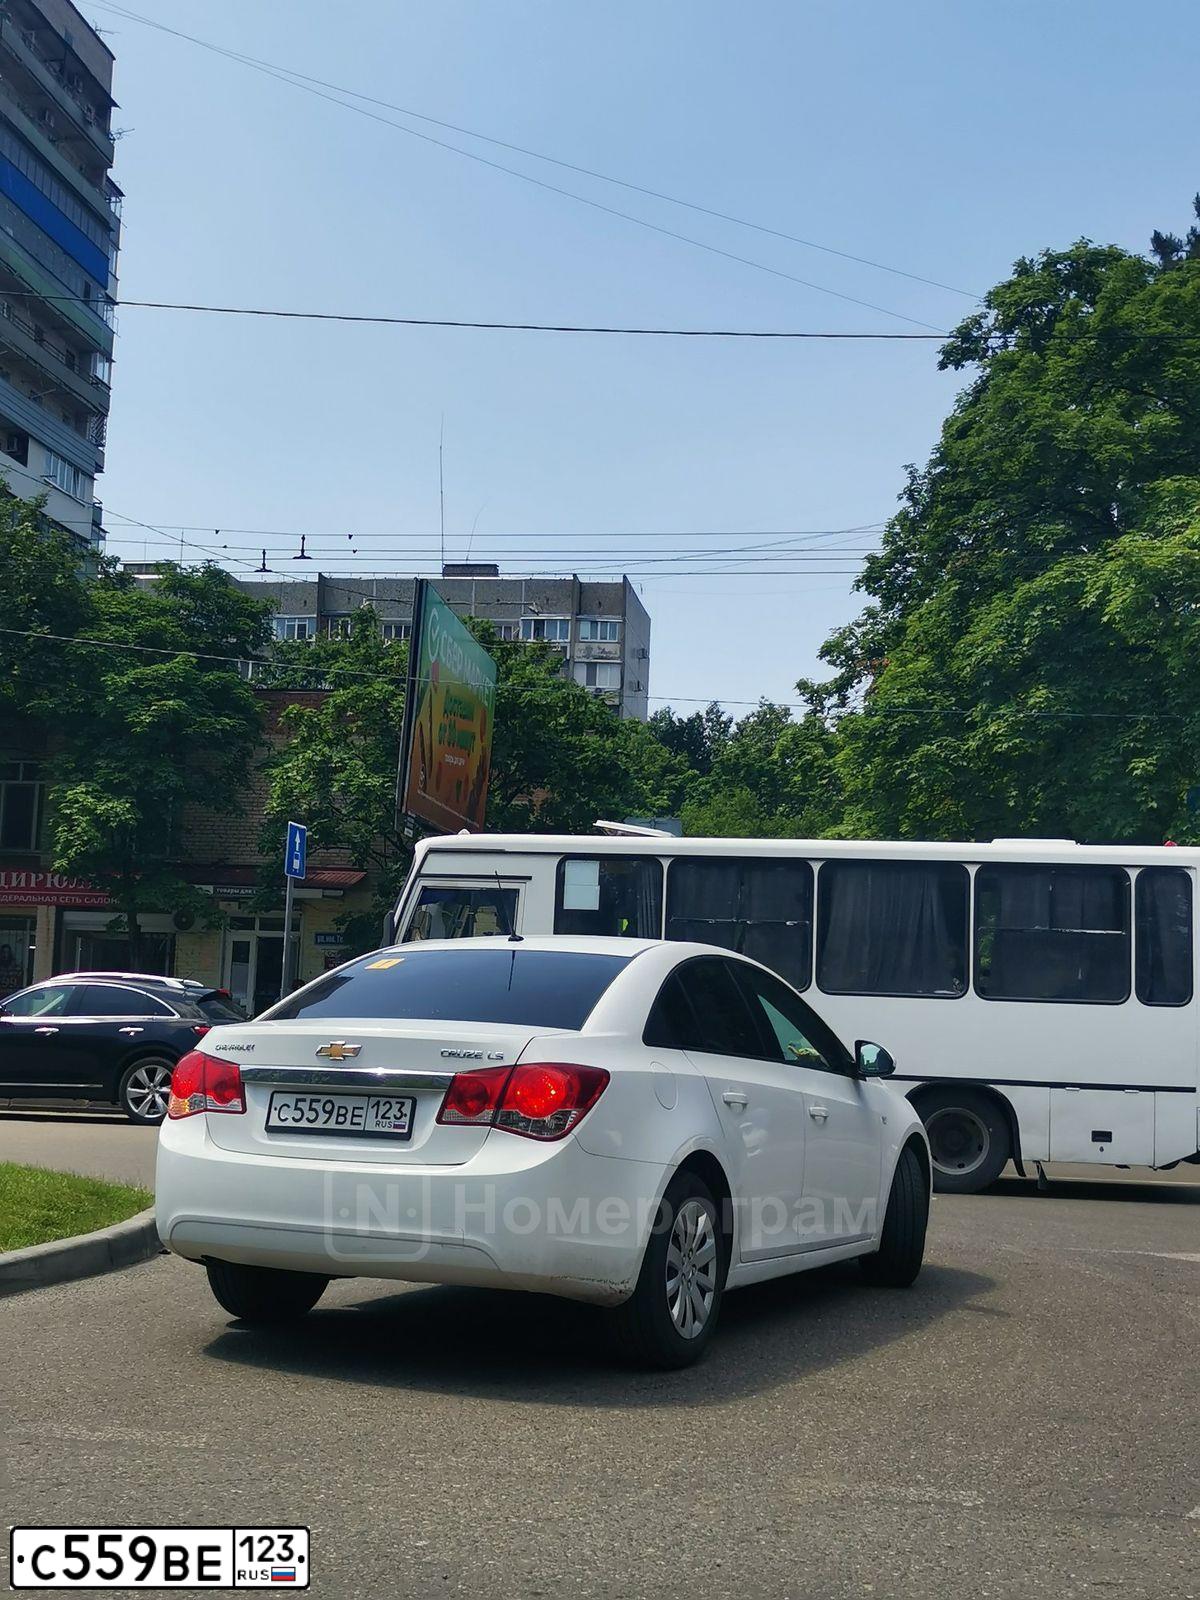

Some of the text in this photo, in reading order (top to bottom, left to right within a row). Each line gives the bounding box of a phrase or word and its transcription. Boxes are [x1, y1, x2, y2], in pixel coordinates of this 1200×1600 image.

[59, 896, 82, 904] СЕТЬ
[440, 1048, 505, 1061] CRUZE LS
[277, 1098, 405, 1126] С559ВЕ 123
[374, 1120, 393, 1129] RUS
